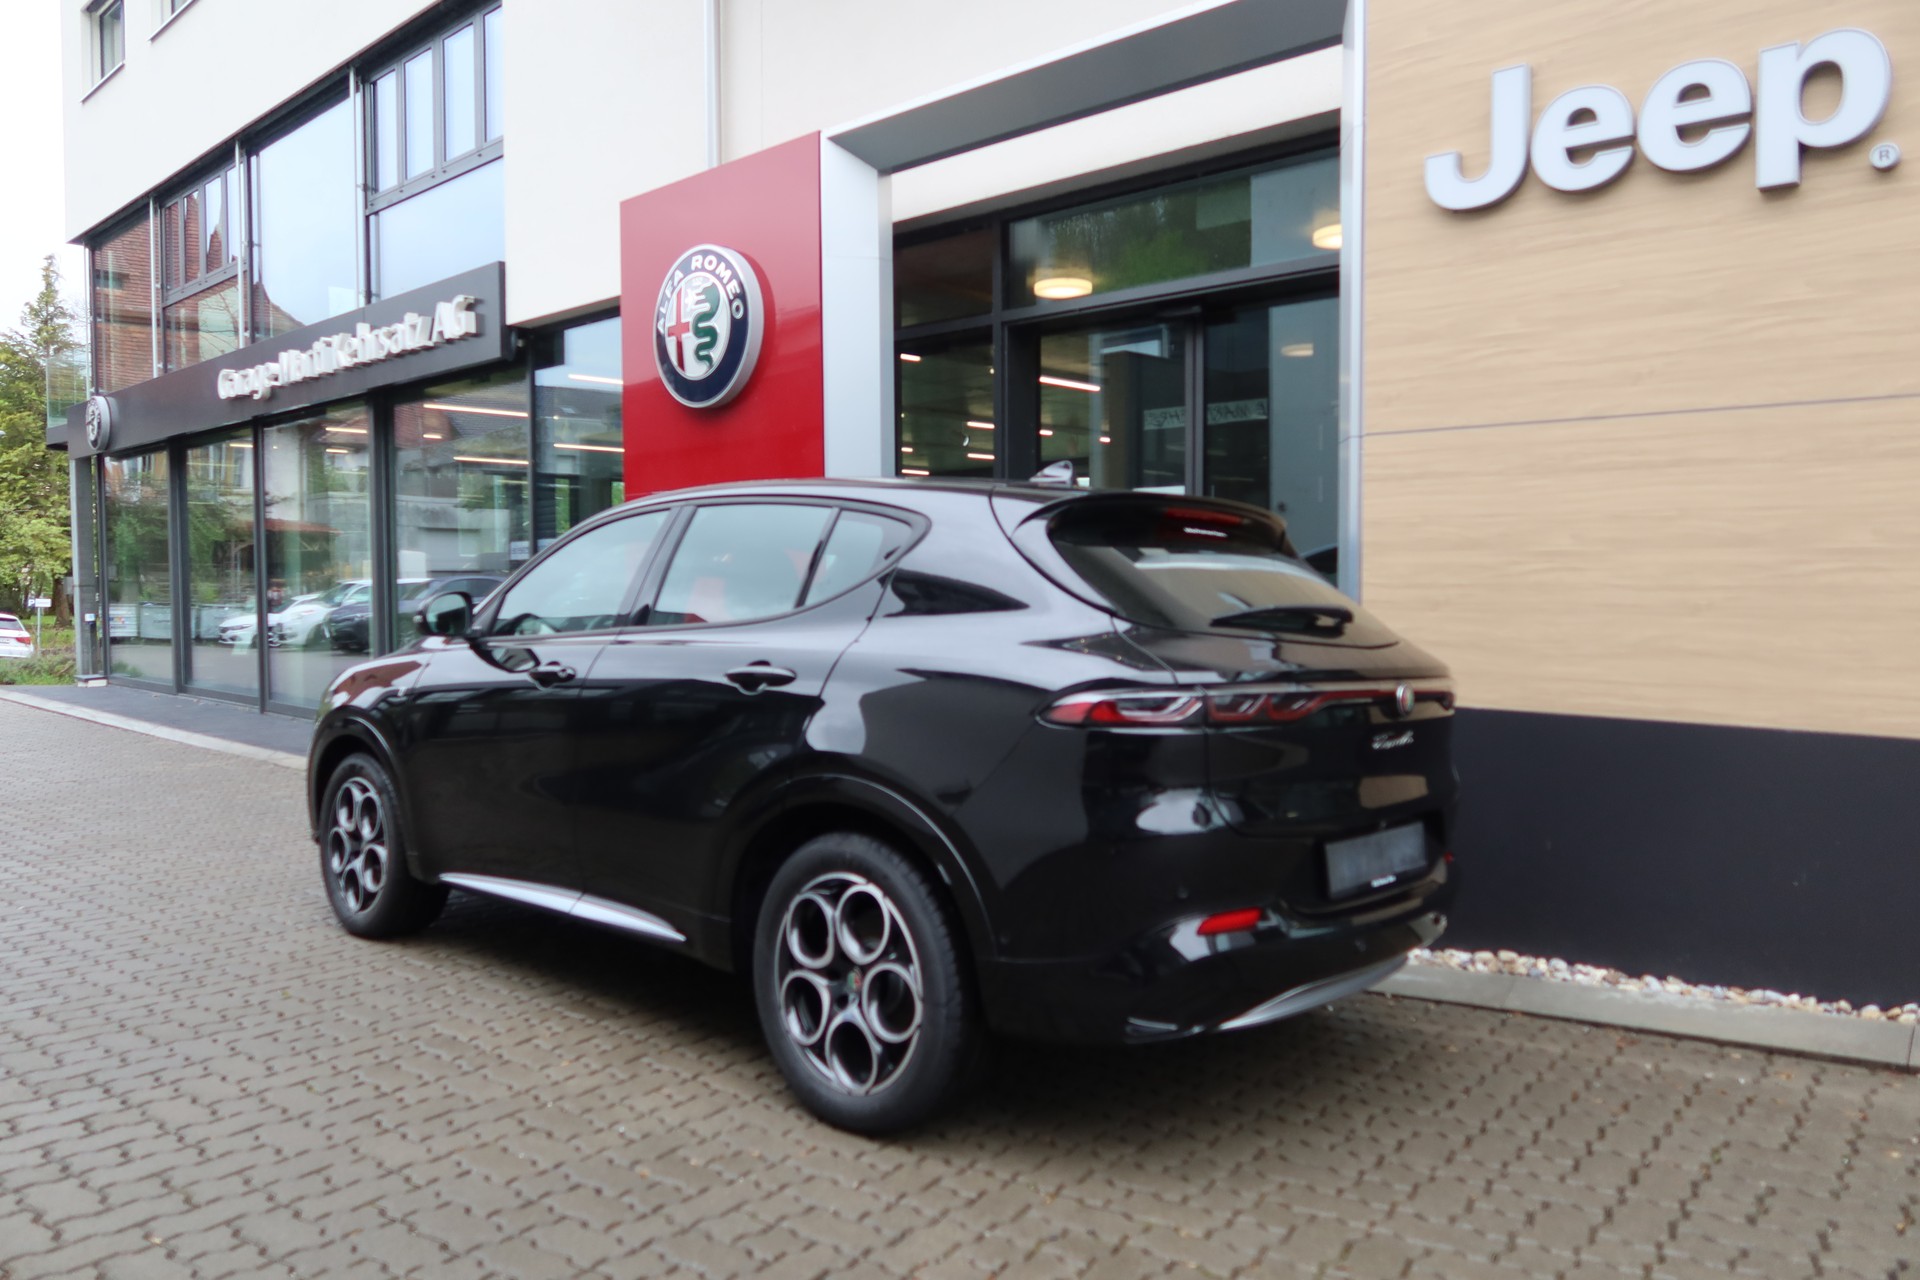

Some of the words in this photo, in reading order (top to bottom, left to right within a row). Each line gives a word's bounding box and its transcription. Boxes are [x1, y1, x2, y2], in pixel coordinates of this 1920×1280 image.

[1425, 29, 1892, 211] Jeep
[657, 269, 684, 334] ALFA
[691, 255, 744, 320] ROMEO
[218, 362, 280, 400] Garage
[432, 295, 477, 343] AG
